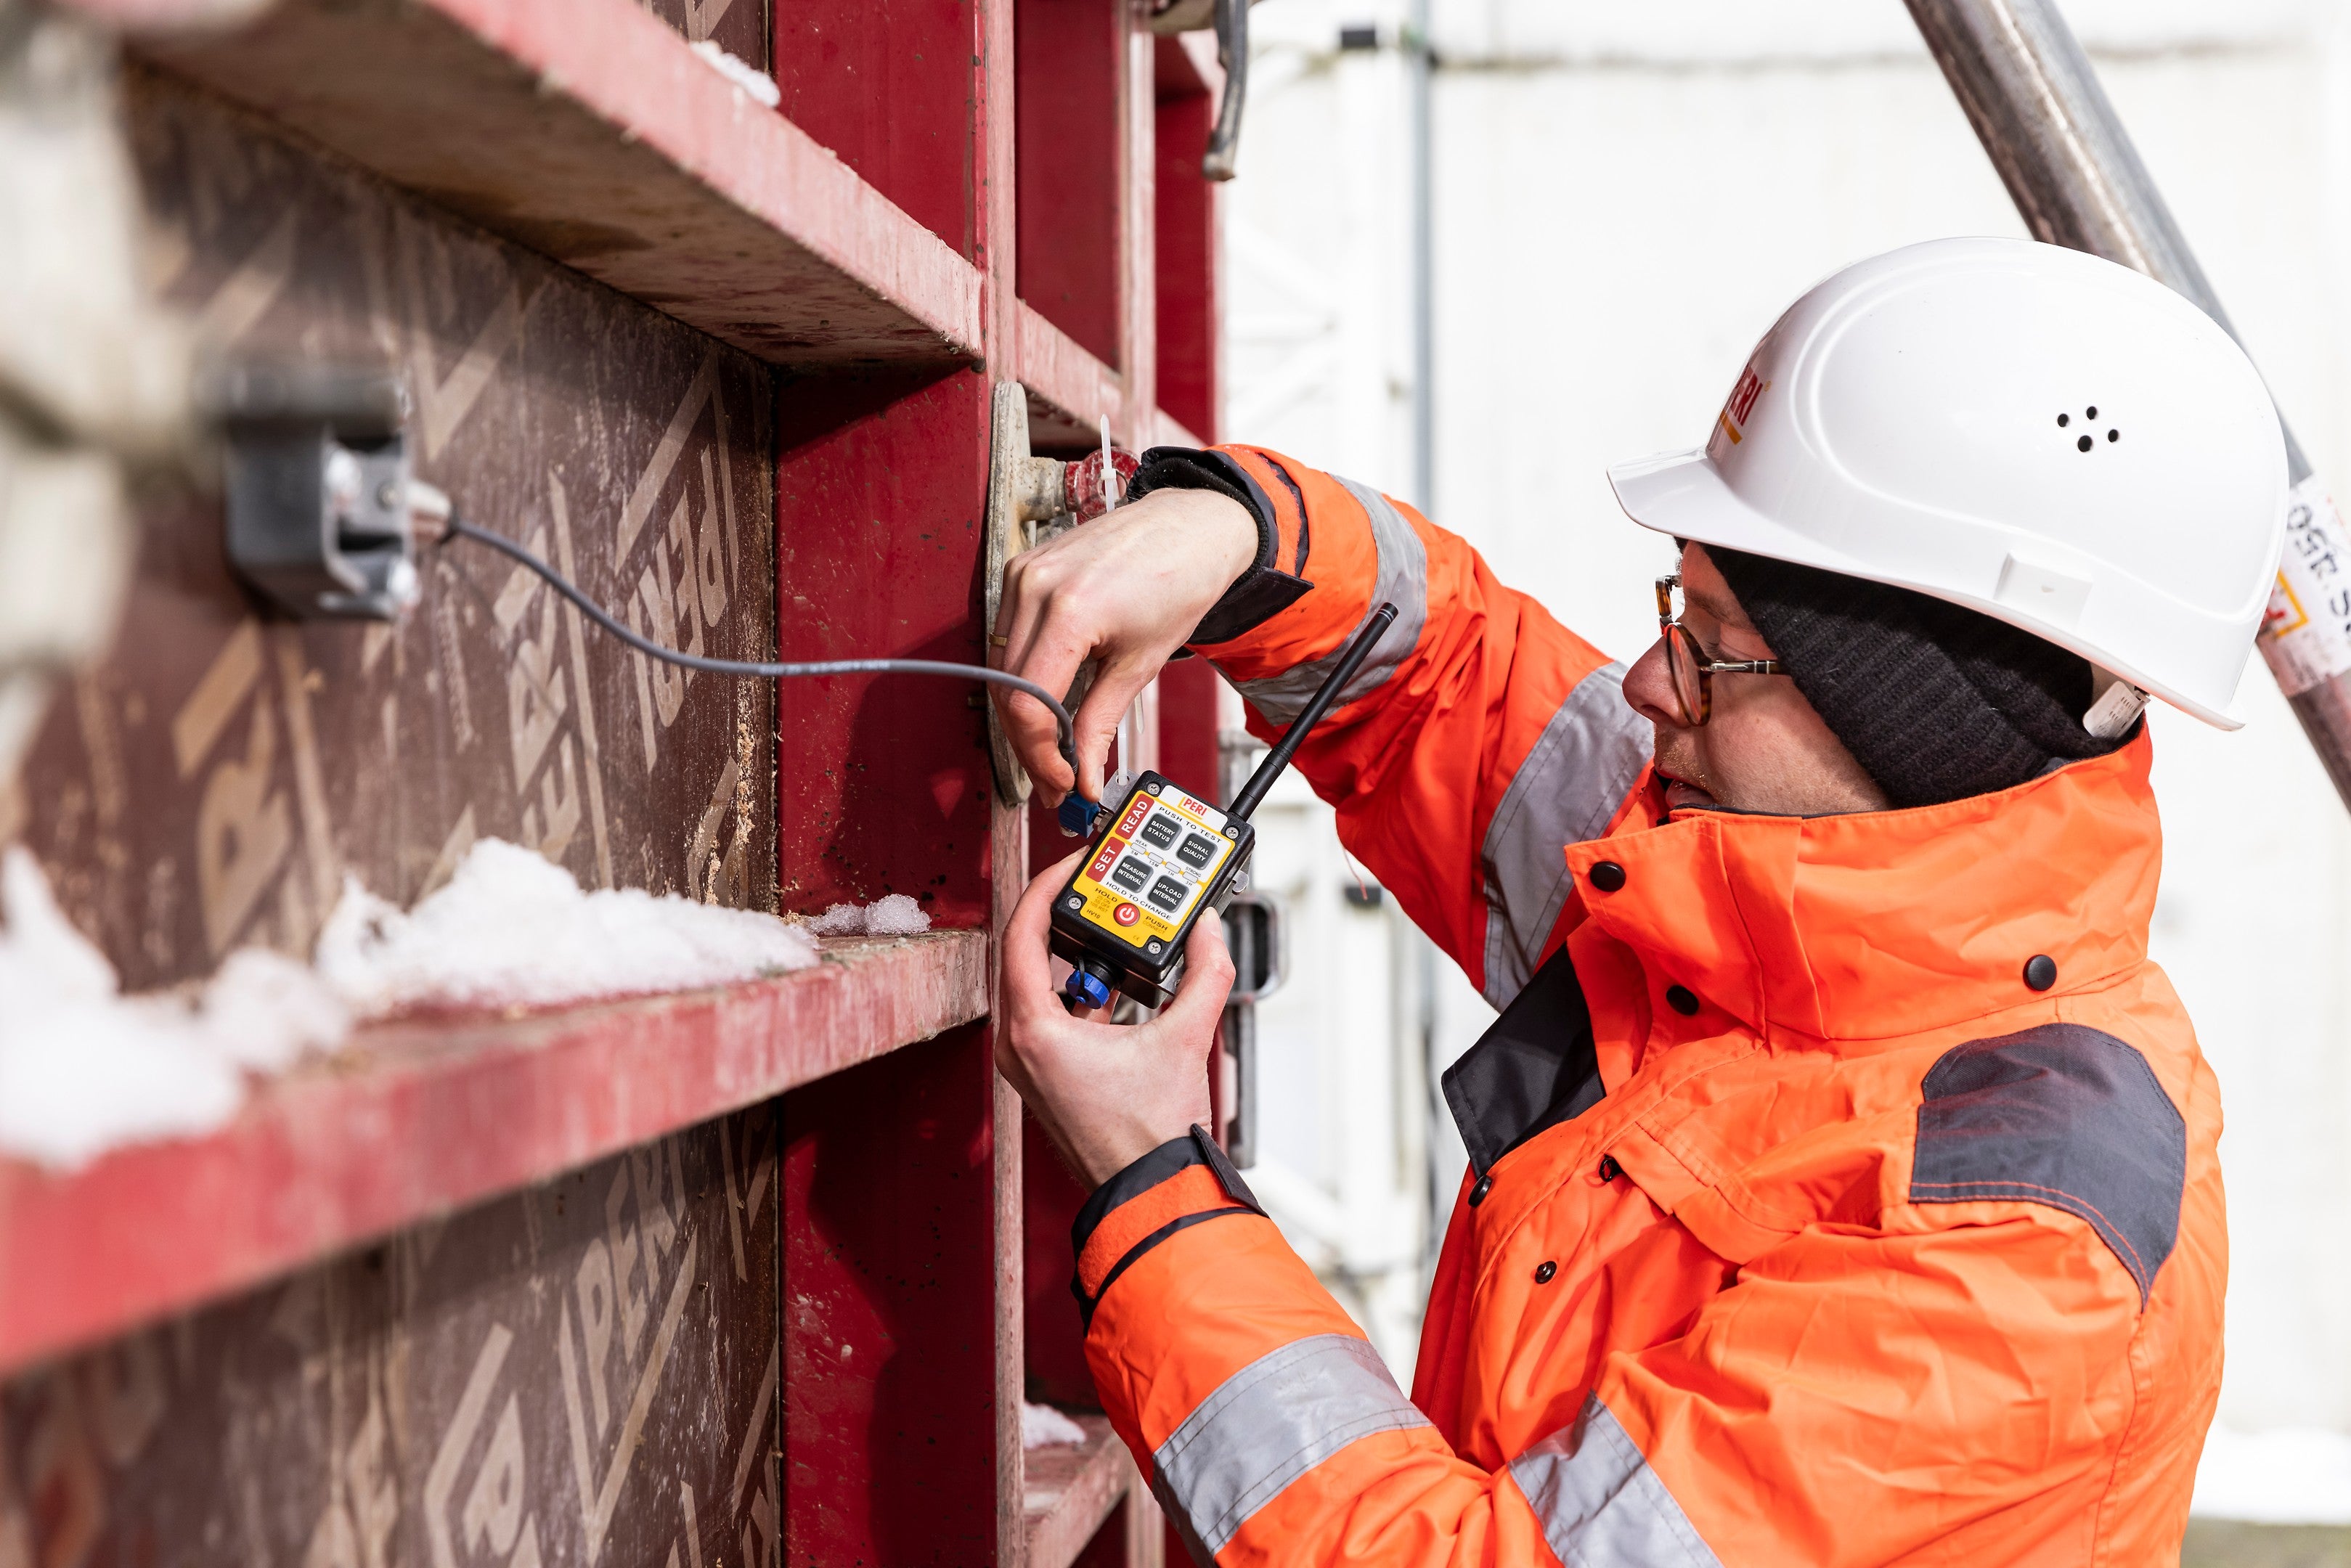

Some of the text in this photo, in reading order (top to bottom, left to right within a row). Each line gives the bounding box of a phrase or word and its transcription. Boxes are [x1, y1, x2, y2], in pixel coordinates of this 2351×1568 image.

[1183, 798, 1207, 816] PERI
[1120, 801, 1148, 833] READ
[1159, 807, 1222, 843] PUSH TO TEST
[1147, 827, 1170, 842] STATUS
[1151, 820, 1176, 836] BATTERY
[1135, 839, 1148, 848] WEAK
[1187, 840, 1209, 855] SIGNAL
[1094, 846, 1116, 872] SET
[1183, 846, 1206, 862] QUALITY
[1117, 868, 1141, 886] INTERVAL
[1121, 862, 1148, 879] MEASURE
[1185, 867, 1202, 878] STRONG
[1095, 888, 1117, 902] HOLD
[1153, 889, 1177, 905] INTERVAL
[1157, 883, 1182, 899] UPLOAD
[1106, 881, 1173, 920] HOLD TO CHANGE
[1086, 909, 1101, 919] HV10
[1145, 915, 1168, 931] PUSH
